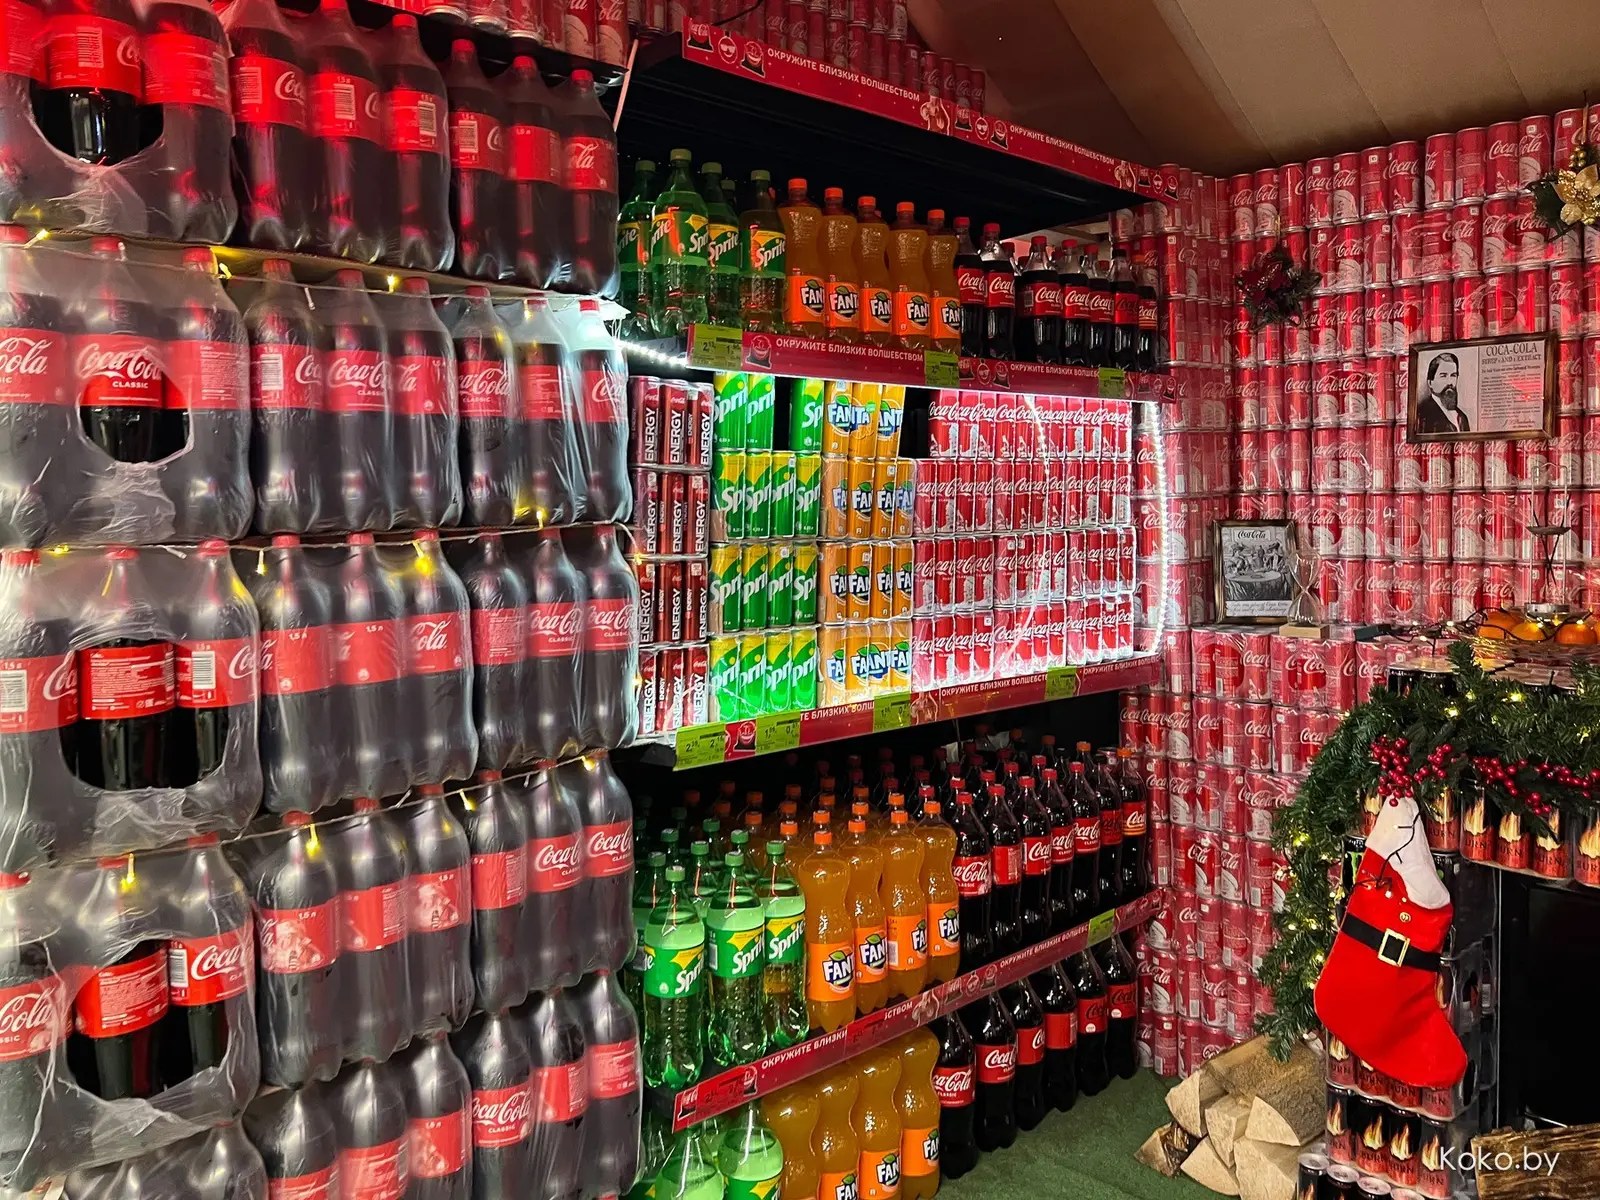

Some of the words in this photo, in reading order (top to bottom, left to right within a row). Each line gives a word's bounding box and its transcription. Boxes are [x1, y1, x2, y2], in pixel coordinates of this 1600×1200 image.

[767, 47, 817, 71] ОКРУЖИТЕ
[819, 64, 860, 83] БЛИЗКИХ
[860, 77, 920, 102] ВОЛШЕБСТВОМ
[1010, 125, 1045, 142] ОКРУЖИТЕ
[1045, 136, 1074, 152] БЛИЗКИХ
[776, 338, 827, 352] ОКРУЖИТЕ
[828, 344, 866, 357] БЛИЗКИХ
[867, 348, 924, 362] ВОЛШЕБСТВОМ
[1010, 363, 1044, 374] ОКРУЖИТЕ
[1045, 366, 1073, 377] БЛИЗКИХ
[1485, 343, 1538, 357] COCA-COLA
[112, 381, 149, 390] CLASSIC
[645, 407, 656, 462] ENERGY
[671, 410, 682, 464] ENERGY
[701, 413, 711, 466] ENERGY
[647, 499, 656, 554] ENERGY
[673, 500, 682, 553] ENERGY
[696, 501, 706, 555] ENERGY
[641, 590, 652, 643] ENERGY
[672, 588, 682, 641] ENERGY
[699, 588, 709, 643] ENERGY
[643, 679, 655, 734] ENERGY
[811, 706, 850, 719] БЛИЗКИХ
[941, 684, 979, 697] ОКРУЖИТЕ
[980, 680, 1011, 692] БЛИЗКИХ
[1000, 946, 1035, 967] ОКРУЖИТЕ
[761, 1043, 812, 1070] ОКРУЖИТЕ
[488, 1124, 516, 1134] CLASSIC
